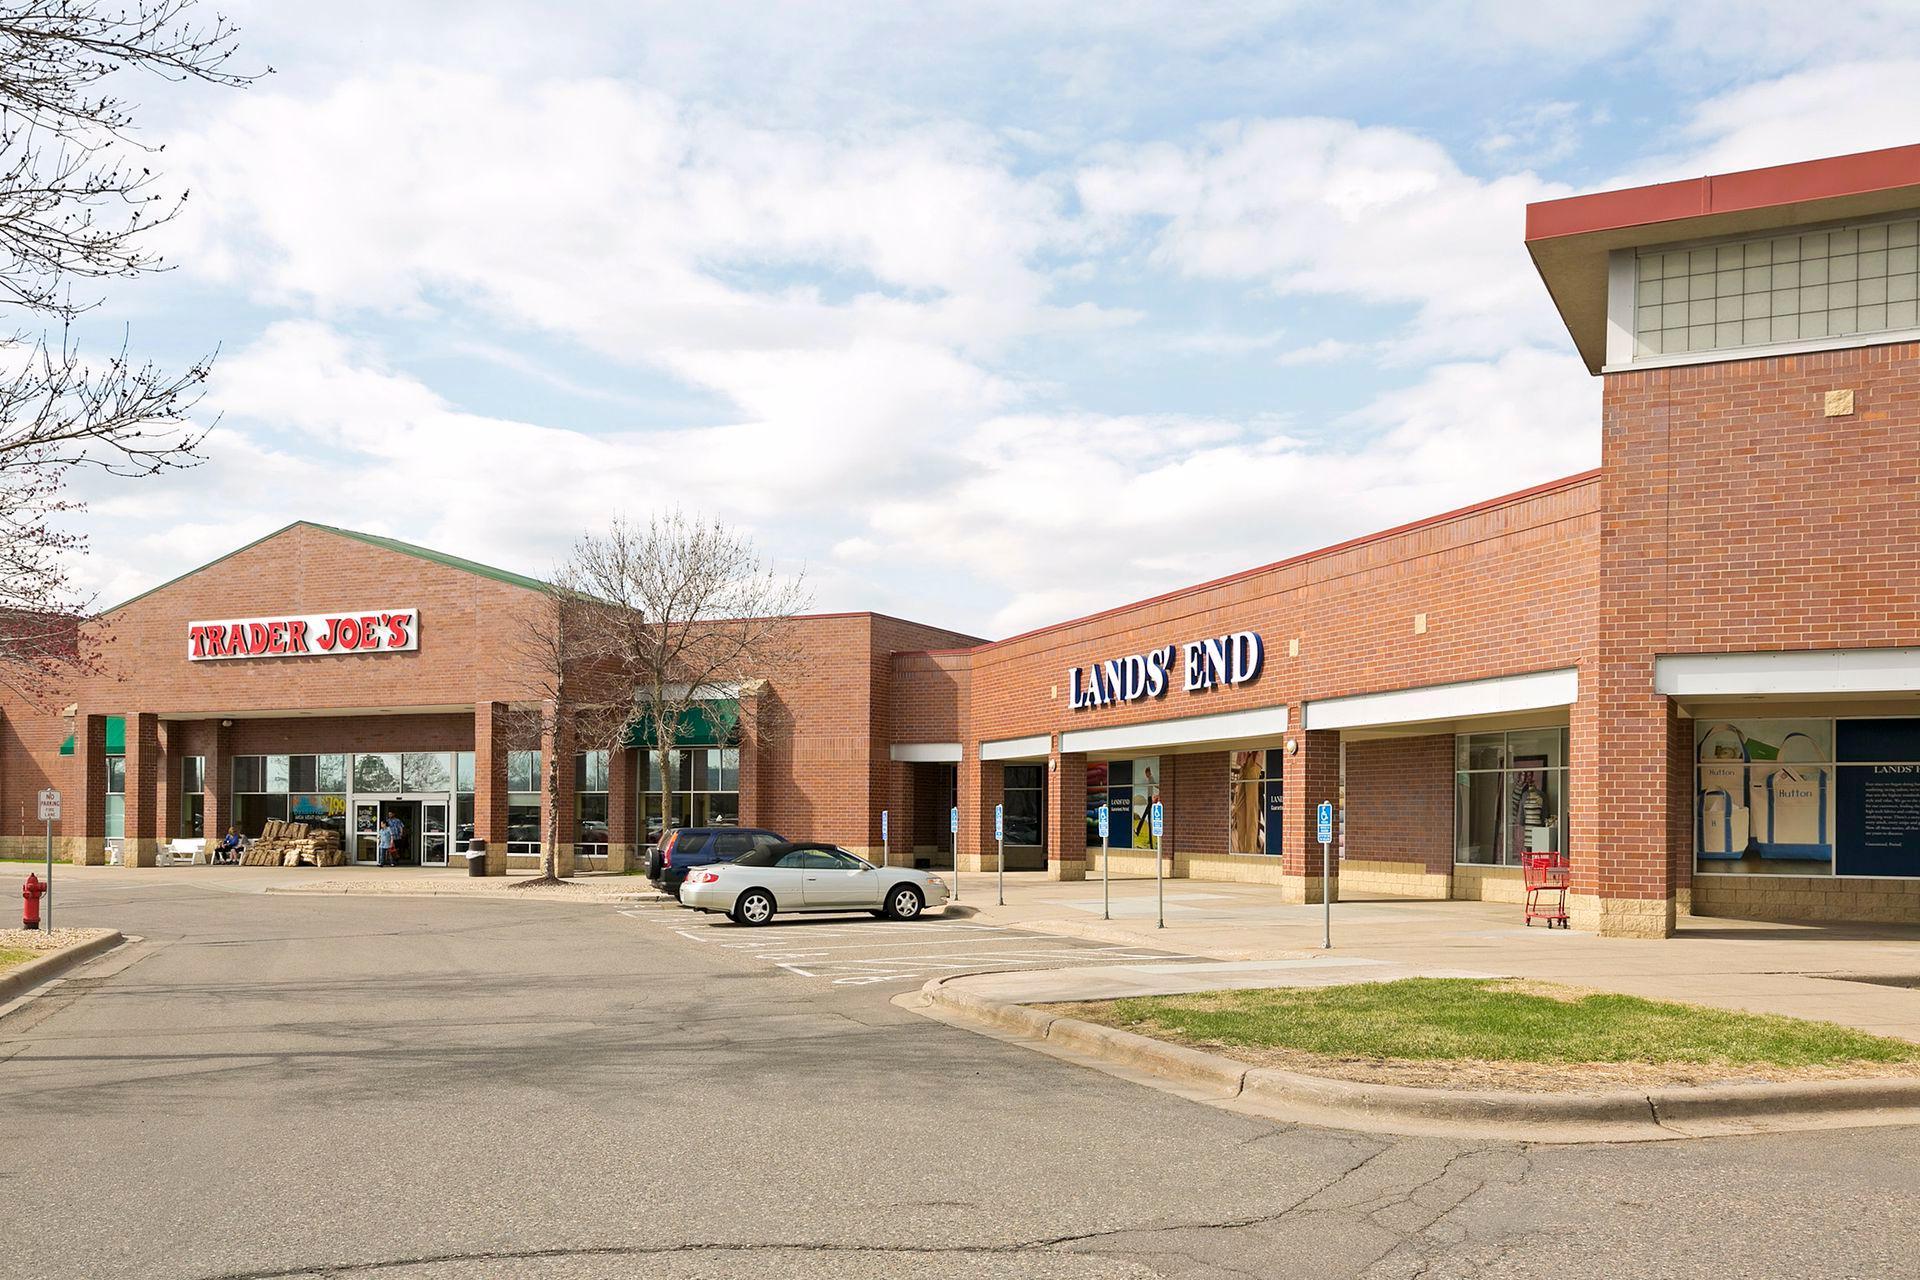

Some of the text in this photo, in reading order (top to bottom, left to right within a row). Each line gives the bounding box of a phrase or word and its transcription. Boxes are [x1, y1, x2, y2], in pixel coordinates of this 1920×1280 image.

[190, 613, 412, 657] TRADER JOE'S
[1068, 631, 1264, 709] LANDS' END
[1779, 789, 1812, 798] Hutton
